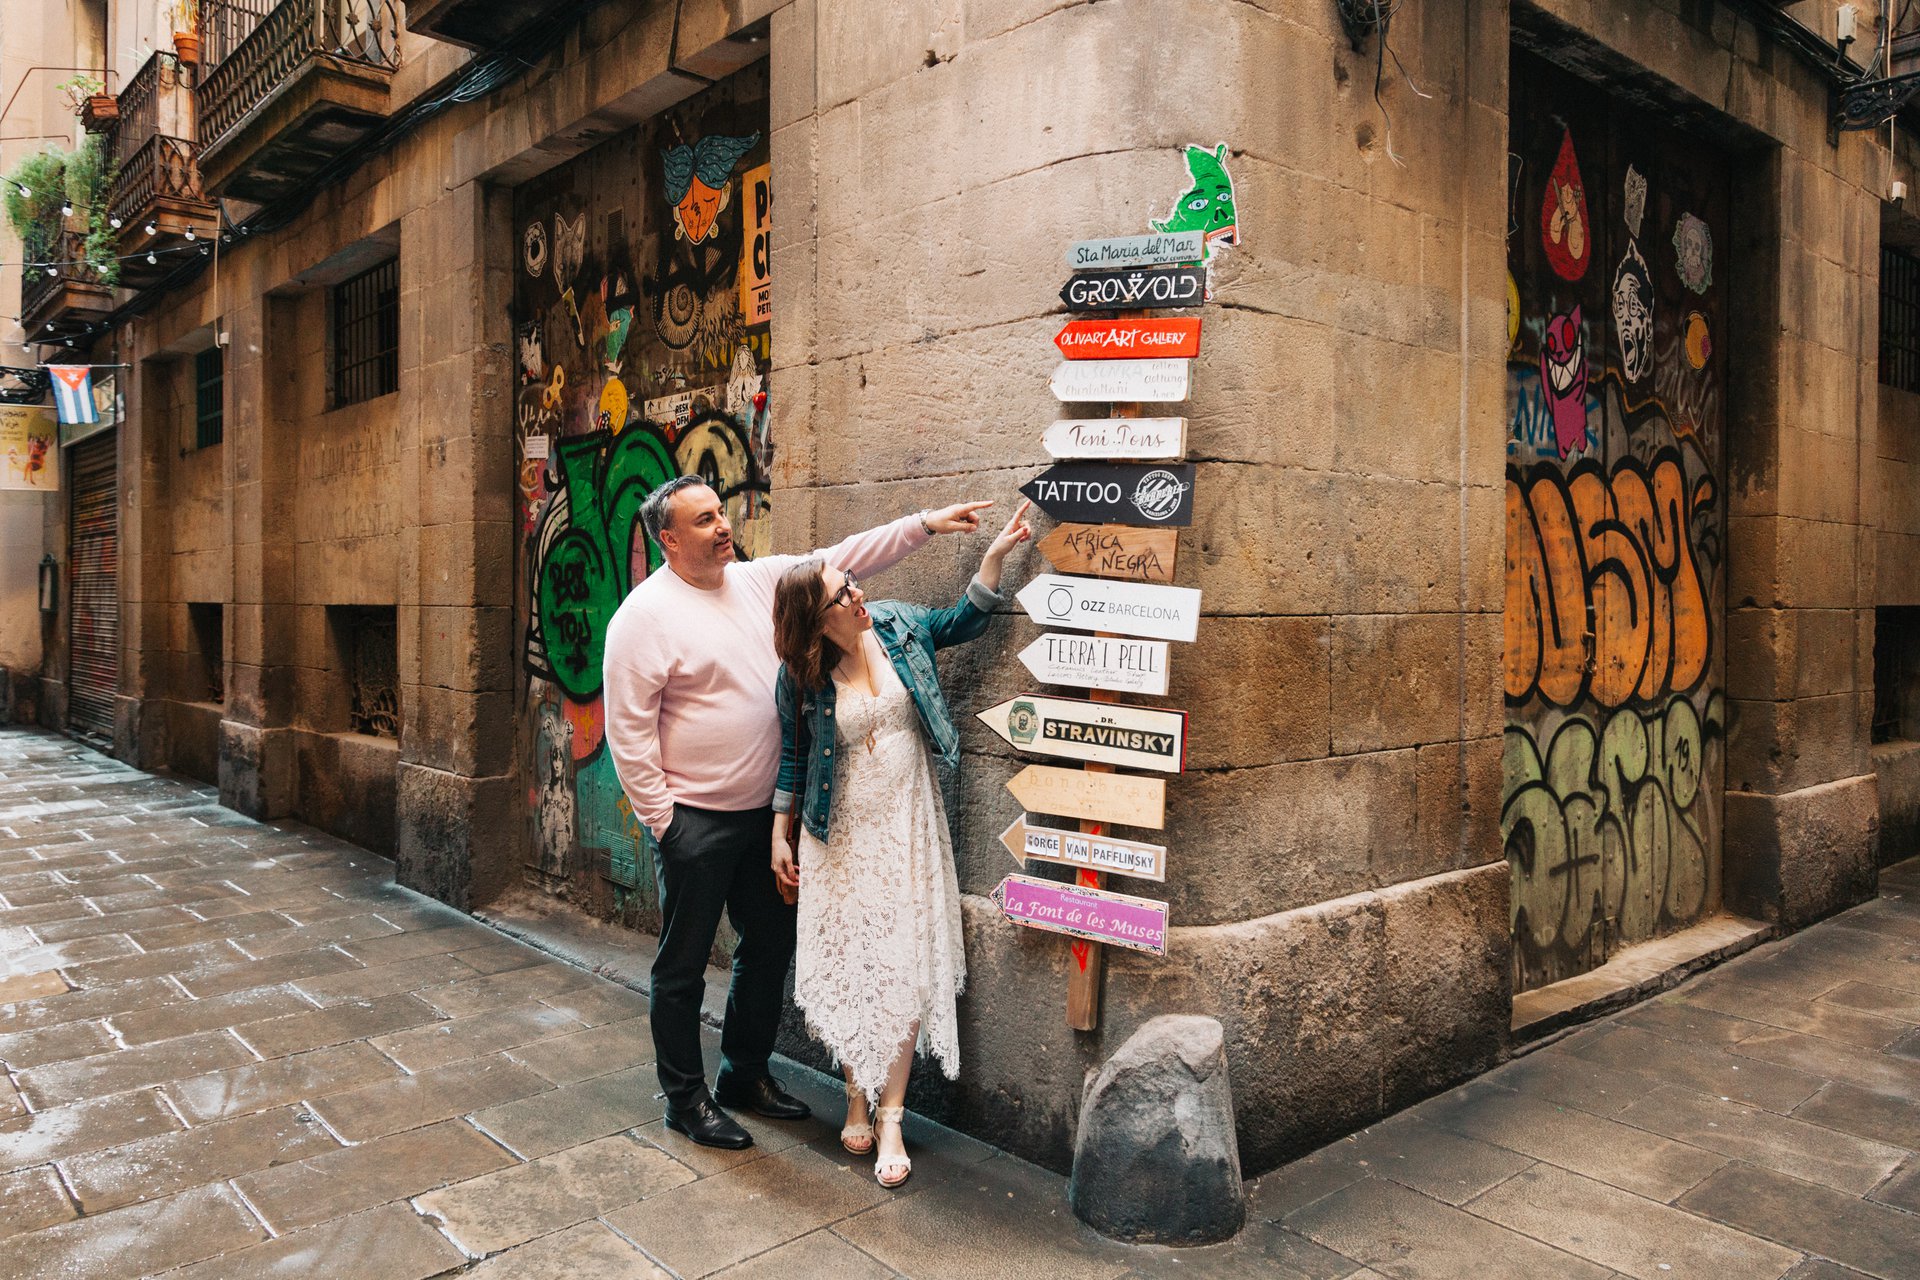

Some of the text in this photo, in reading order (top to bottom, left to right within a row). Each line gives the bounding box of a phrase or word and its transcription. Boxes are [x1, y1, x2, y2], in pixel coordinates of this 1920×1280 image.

[755, 178, 771, 230] P
[1077, 237, 1196, 265] Sta Maria del Mar
[758, 289, 771, 304] MO
[1141, 332, 1187, 345] GALLERY
[676, 415, 689, 427] DFM
[1068, 424, 1166, 448] Toni Pons
[1034, 480, 1122, 504] TATTOO
[1102, 550, 1164, 579] NEGRA
[1081, 599, 1181, 622] OZZ BARCELONA
[1045, 638, 1096, 667] TERRA
[1119, 644, 1160, 674] PELL
[1045, 721, 1173, 754] STRAVINSKY
[1675, 735, 1689, 772] 19
[1066, 842, 1088, 858] VAN
[1092, 847, 1154, 869] PAFFLINSKY
[1060, 893, 1098, 909] Restaurant
[1005, 896, 1163, 942] La Font de les Muses
